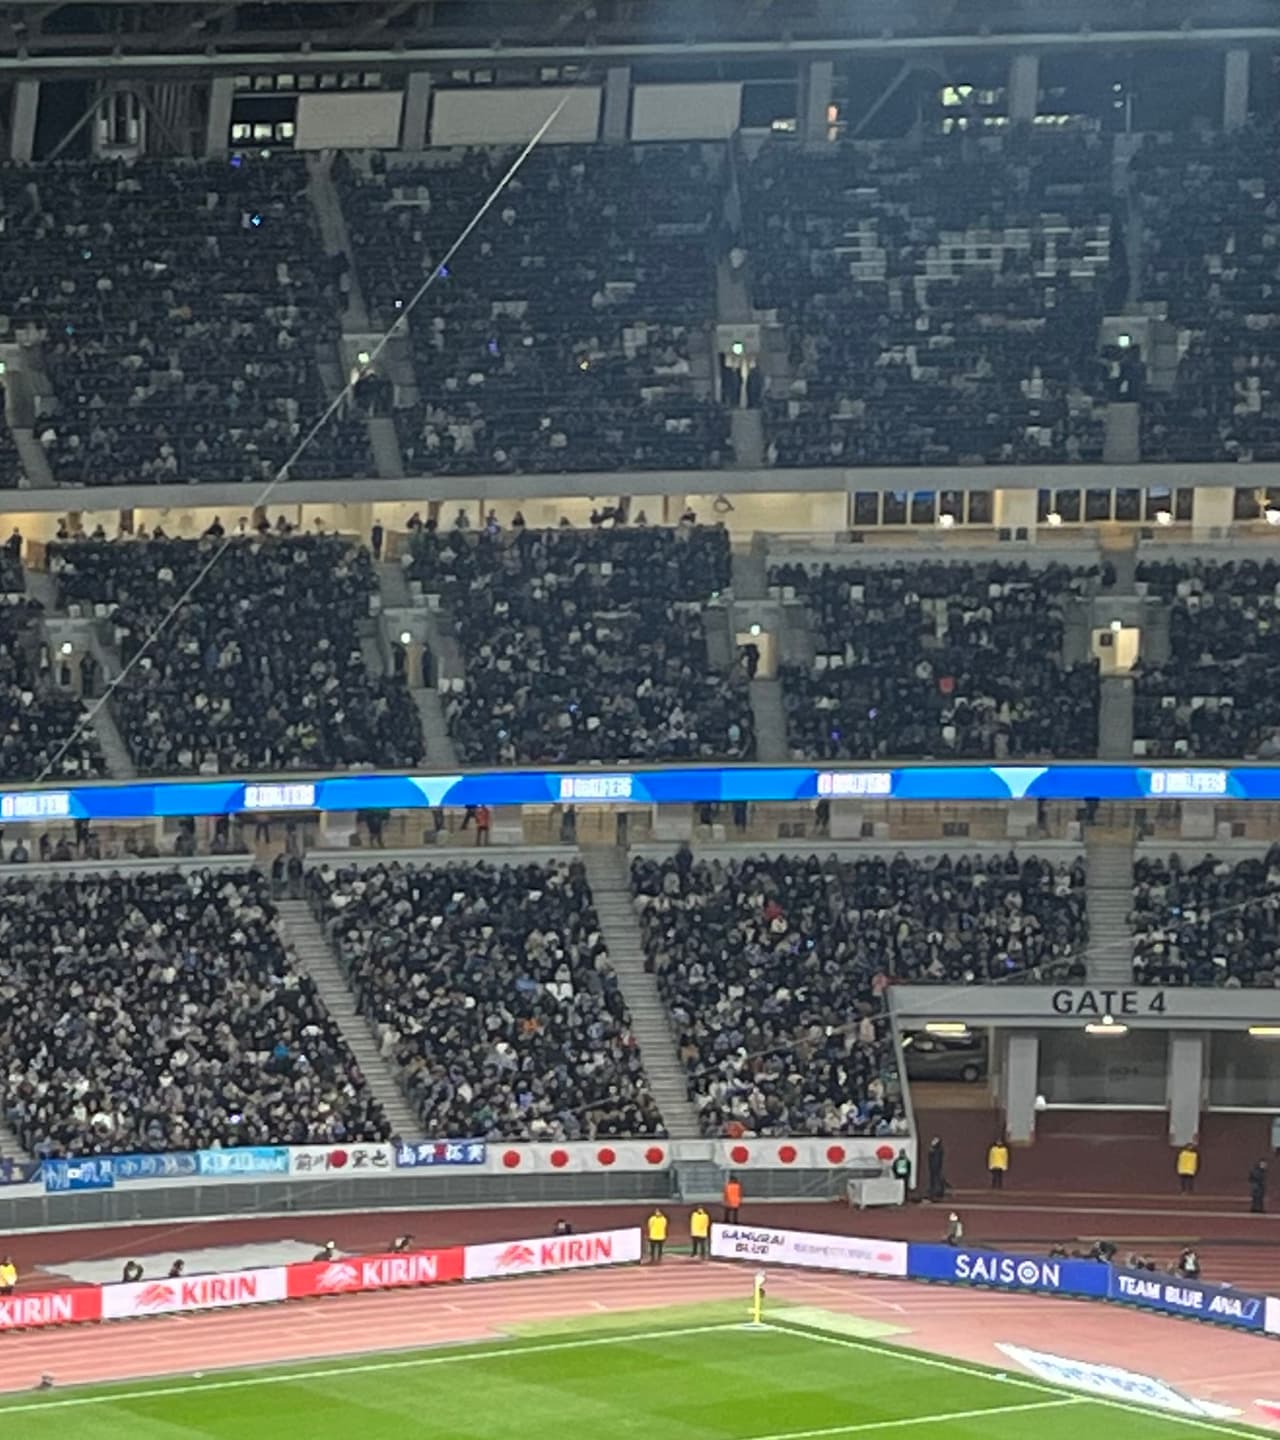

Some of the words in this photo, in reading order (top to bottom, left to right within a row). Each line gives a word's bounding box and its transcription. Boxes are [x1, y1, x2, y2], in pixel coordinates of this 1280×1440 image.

[1052, 990, 1138, 1014] GATE
[1149, 991, 1166, 1013] 4
[536, 1236, 612, 1267] KIRIN
[722, 1230, 784, 1245] SAMURAI
[363, 1255, 438, 1286] KIRIN
[955, 1254, 1060, 1288] SAISON
[181, 1273, 257, 1305] KIRIN
[1118, 1275, 1161, 1300] TEAM
[1165, 1285, 1204, 1309] BLUE
[1208, 1295, 1243, 1318] ANA
